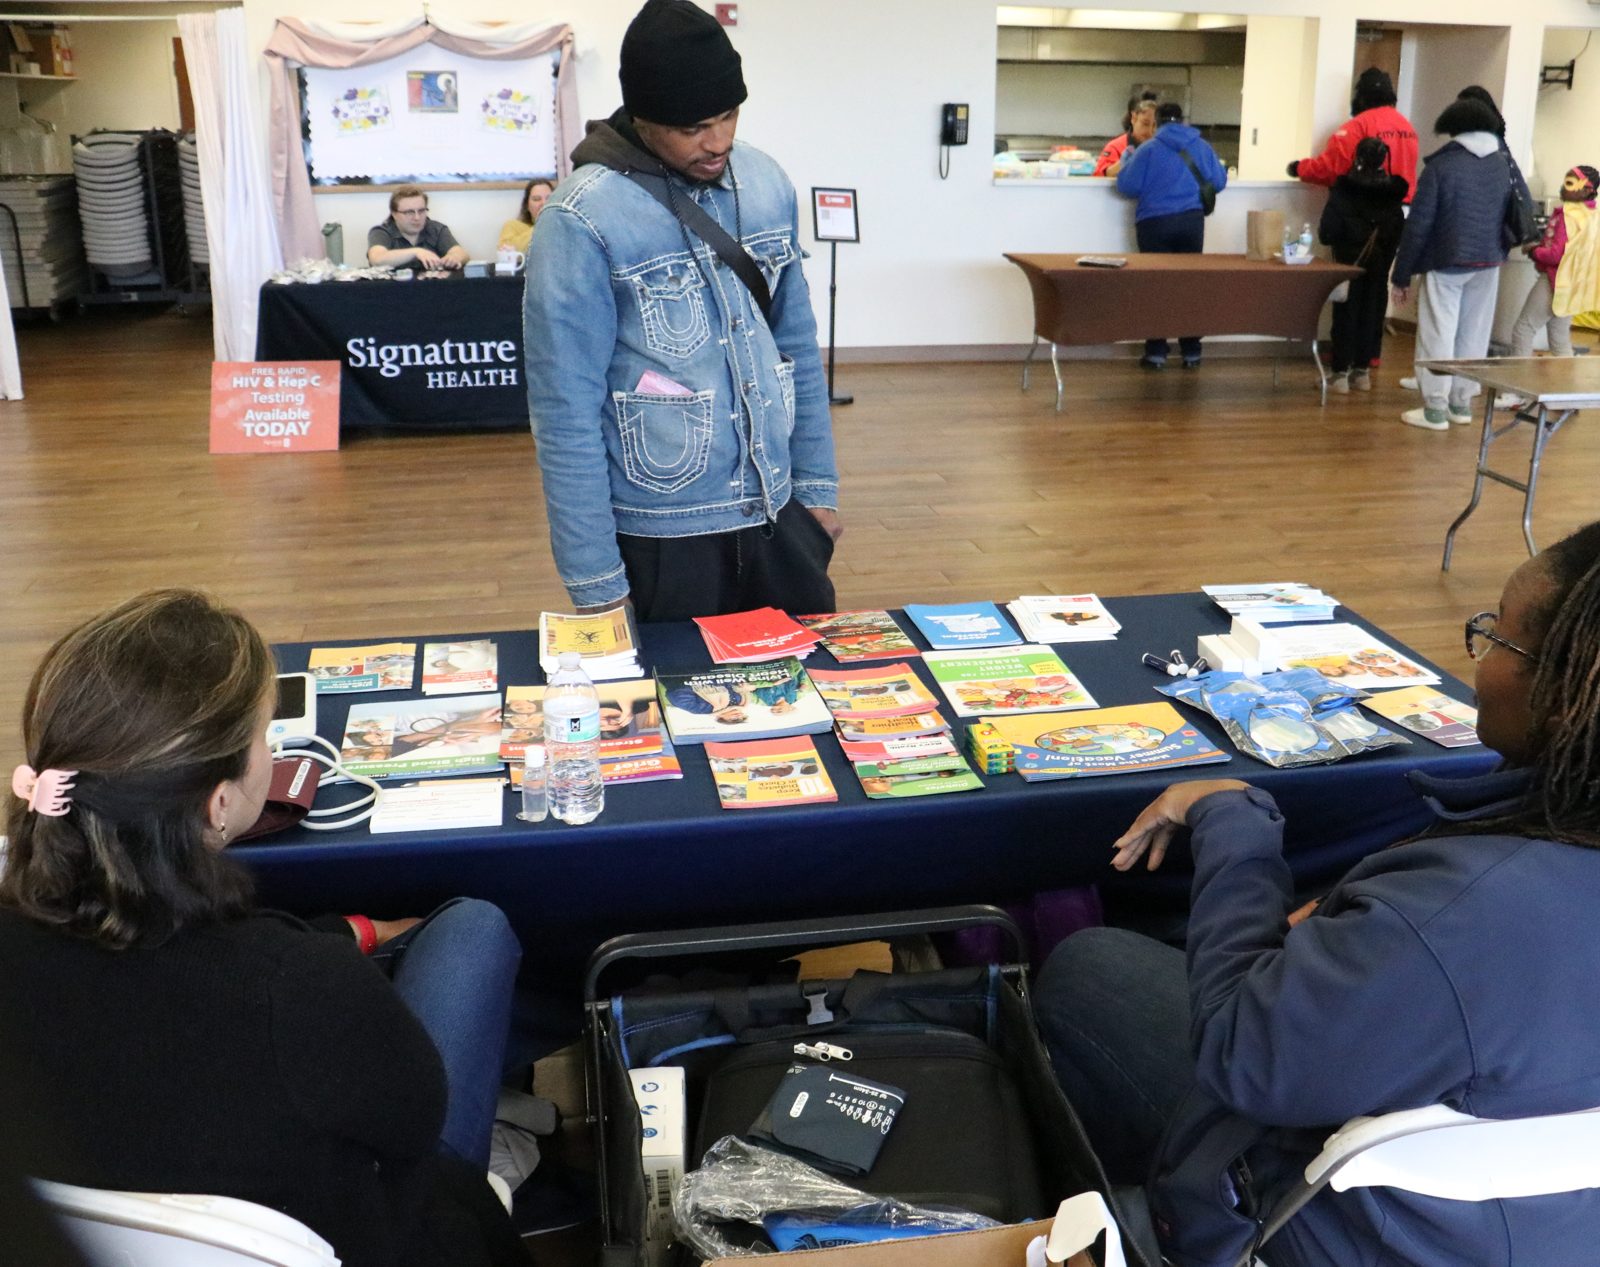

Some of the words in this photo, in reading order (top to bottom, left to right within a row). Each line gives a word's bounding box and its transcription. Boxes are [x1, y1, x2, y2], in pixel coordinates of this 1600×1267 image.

[346, 337, 517, 378] Signature
[277, 367, 306, 376] RAPID
[232, 376, 260, 388] HIV
[263, 376, 275, 388] &
[278, 376, 307, 389] Hep
[310, 375, 321, 387] C
[426, 368, 518, 389] HEALTH
[250, 391, 305, 406] Testing
[244, 407, 310, 421] Available
[242, 421, 312, 437] TODAY
[939, 657, 1021, 668] MANAGEMENT
[691, 673, 746, 681] Disease
[748, 668, 789, 677] Heart
[748, 673, 791, 682] Living
[1128, 745, 1182, 759] Summer
[411, 759, 451, 767] Blood
[454, 756, 487, 764] High
[1045, 754, 1125, 763] Vacation!
[1141, 754, 1170, 764] Make
[345, 762, 407, 770] Pressure
[613, 759, 661, 771] Grief
[799, 776, 830, 796] 10
